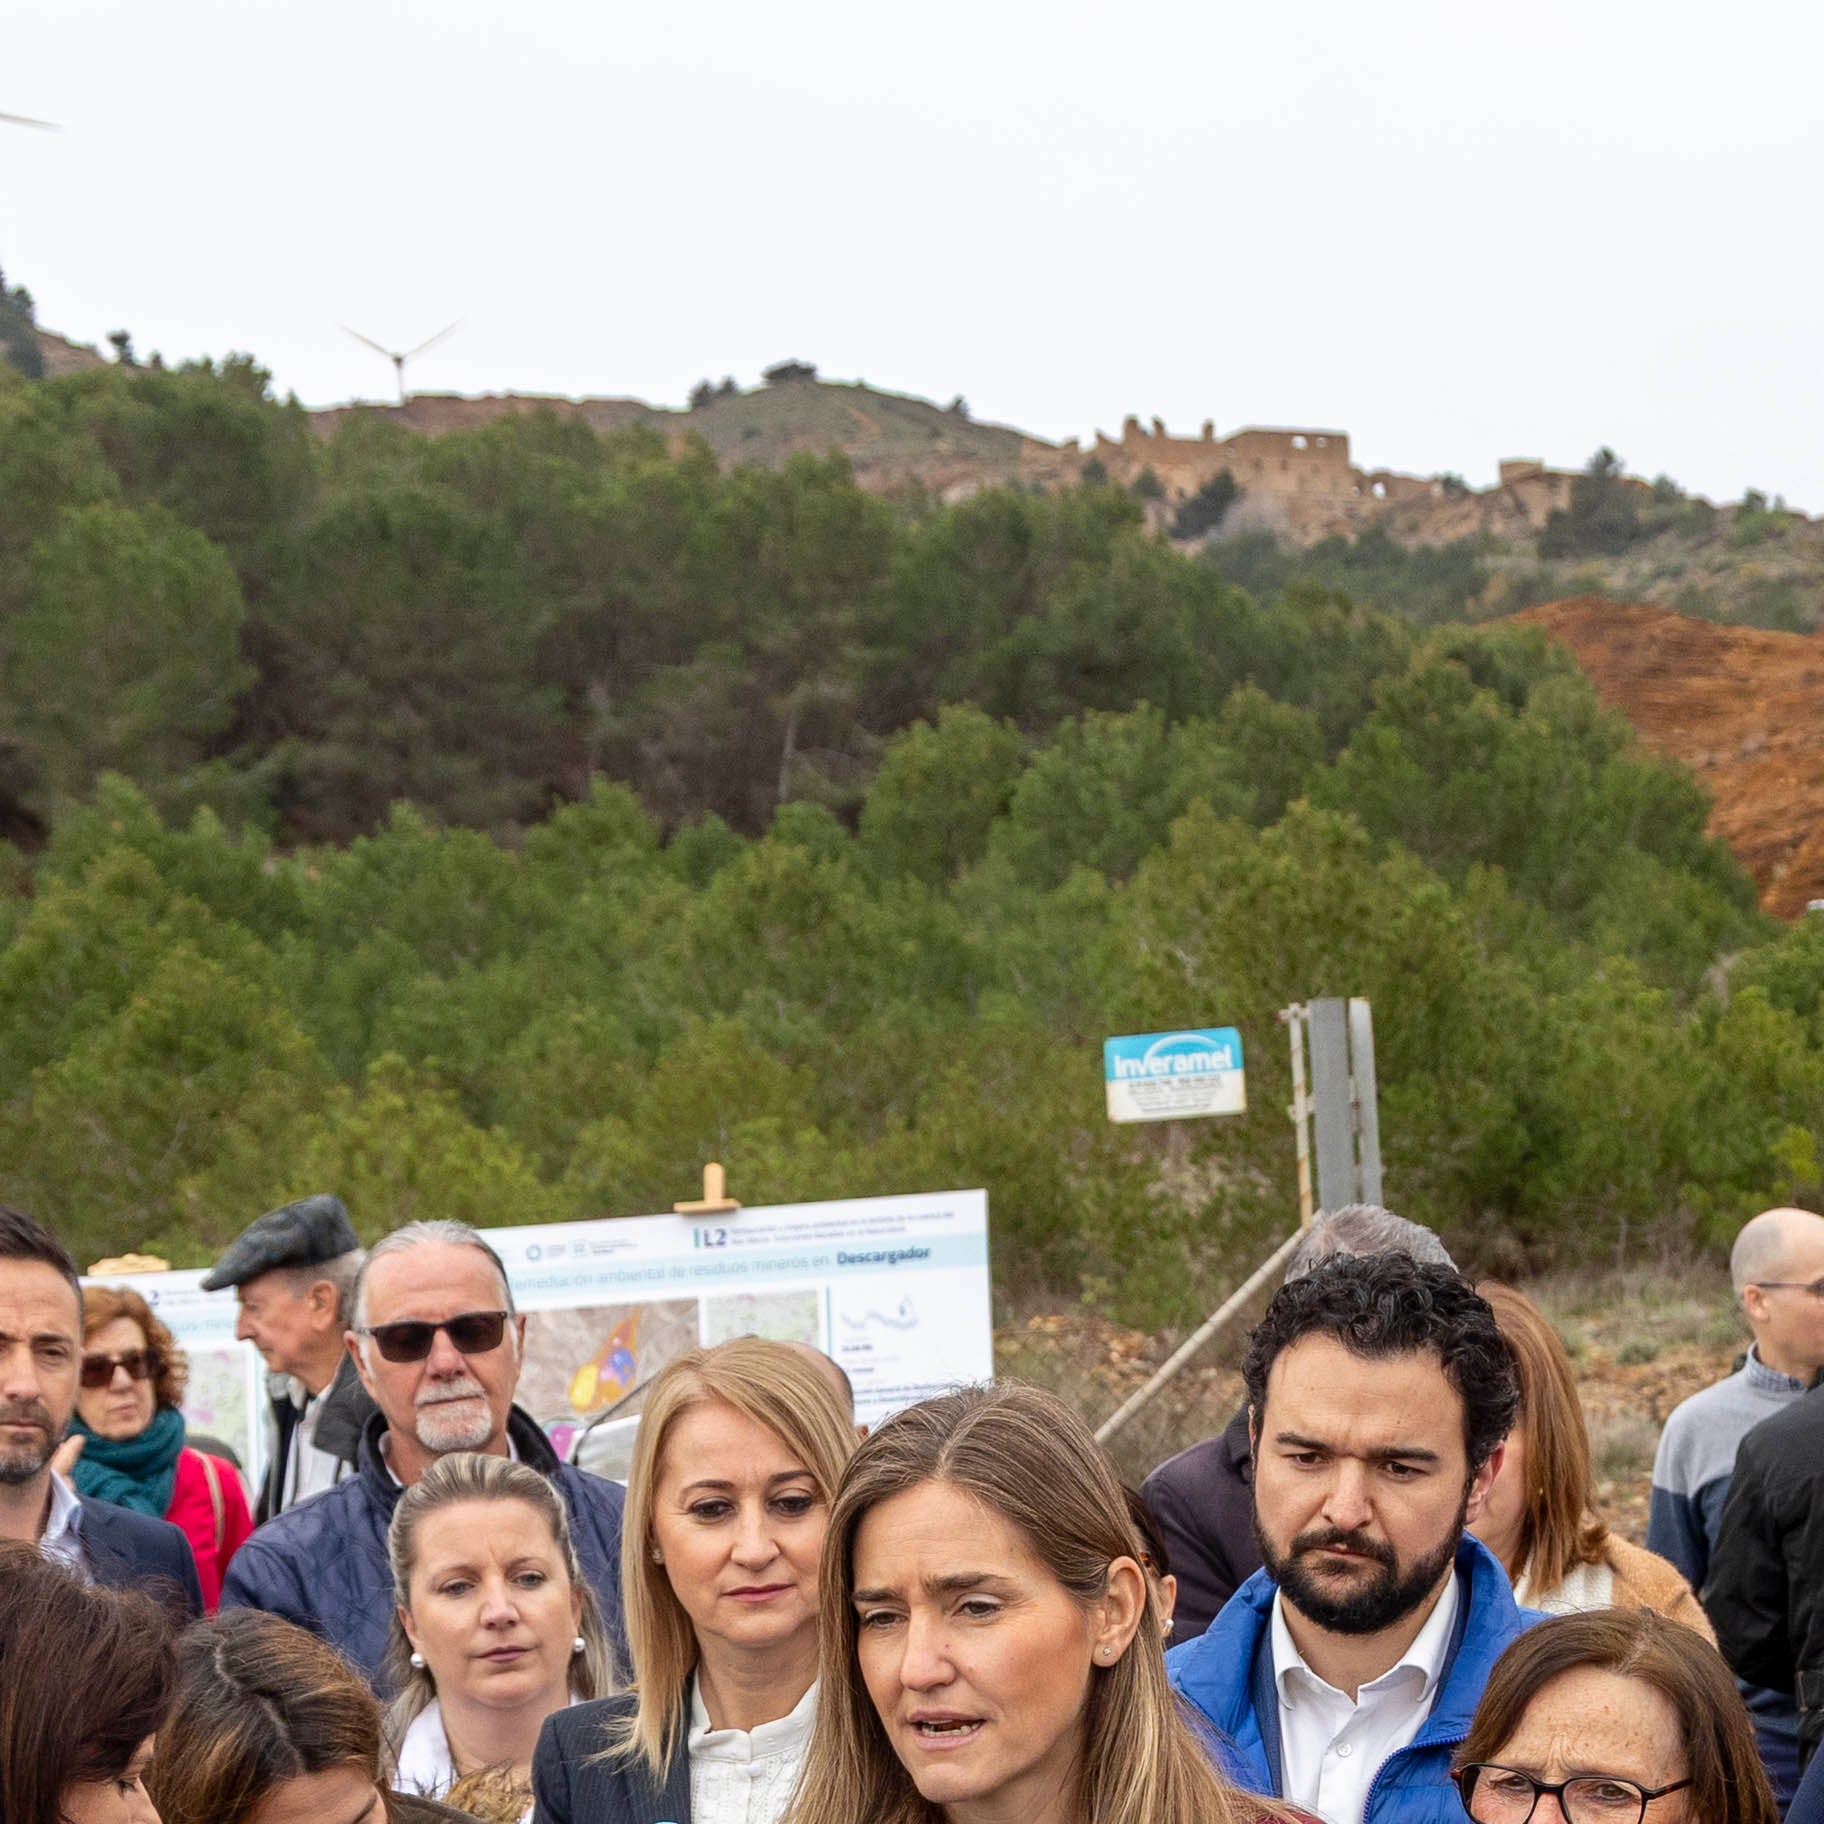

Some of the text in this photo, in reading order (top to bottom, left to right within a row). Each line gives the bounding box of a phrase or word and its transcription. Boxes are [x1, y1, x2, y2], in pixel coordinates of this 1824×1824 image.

[1114, 1043, 1233, 1078] Inveramel
[752, 1256, 810, 1272] mineros
[836, 1245, 931, 1266] Descargador
